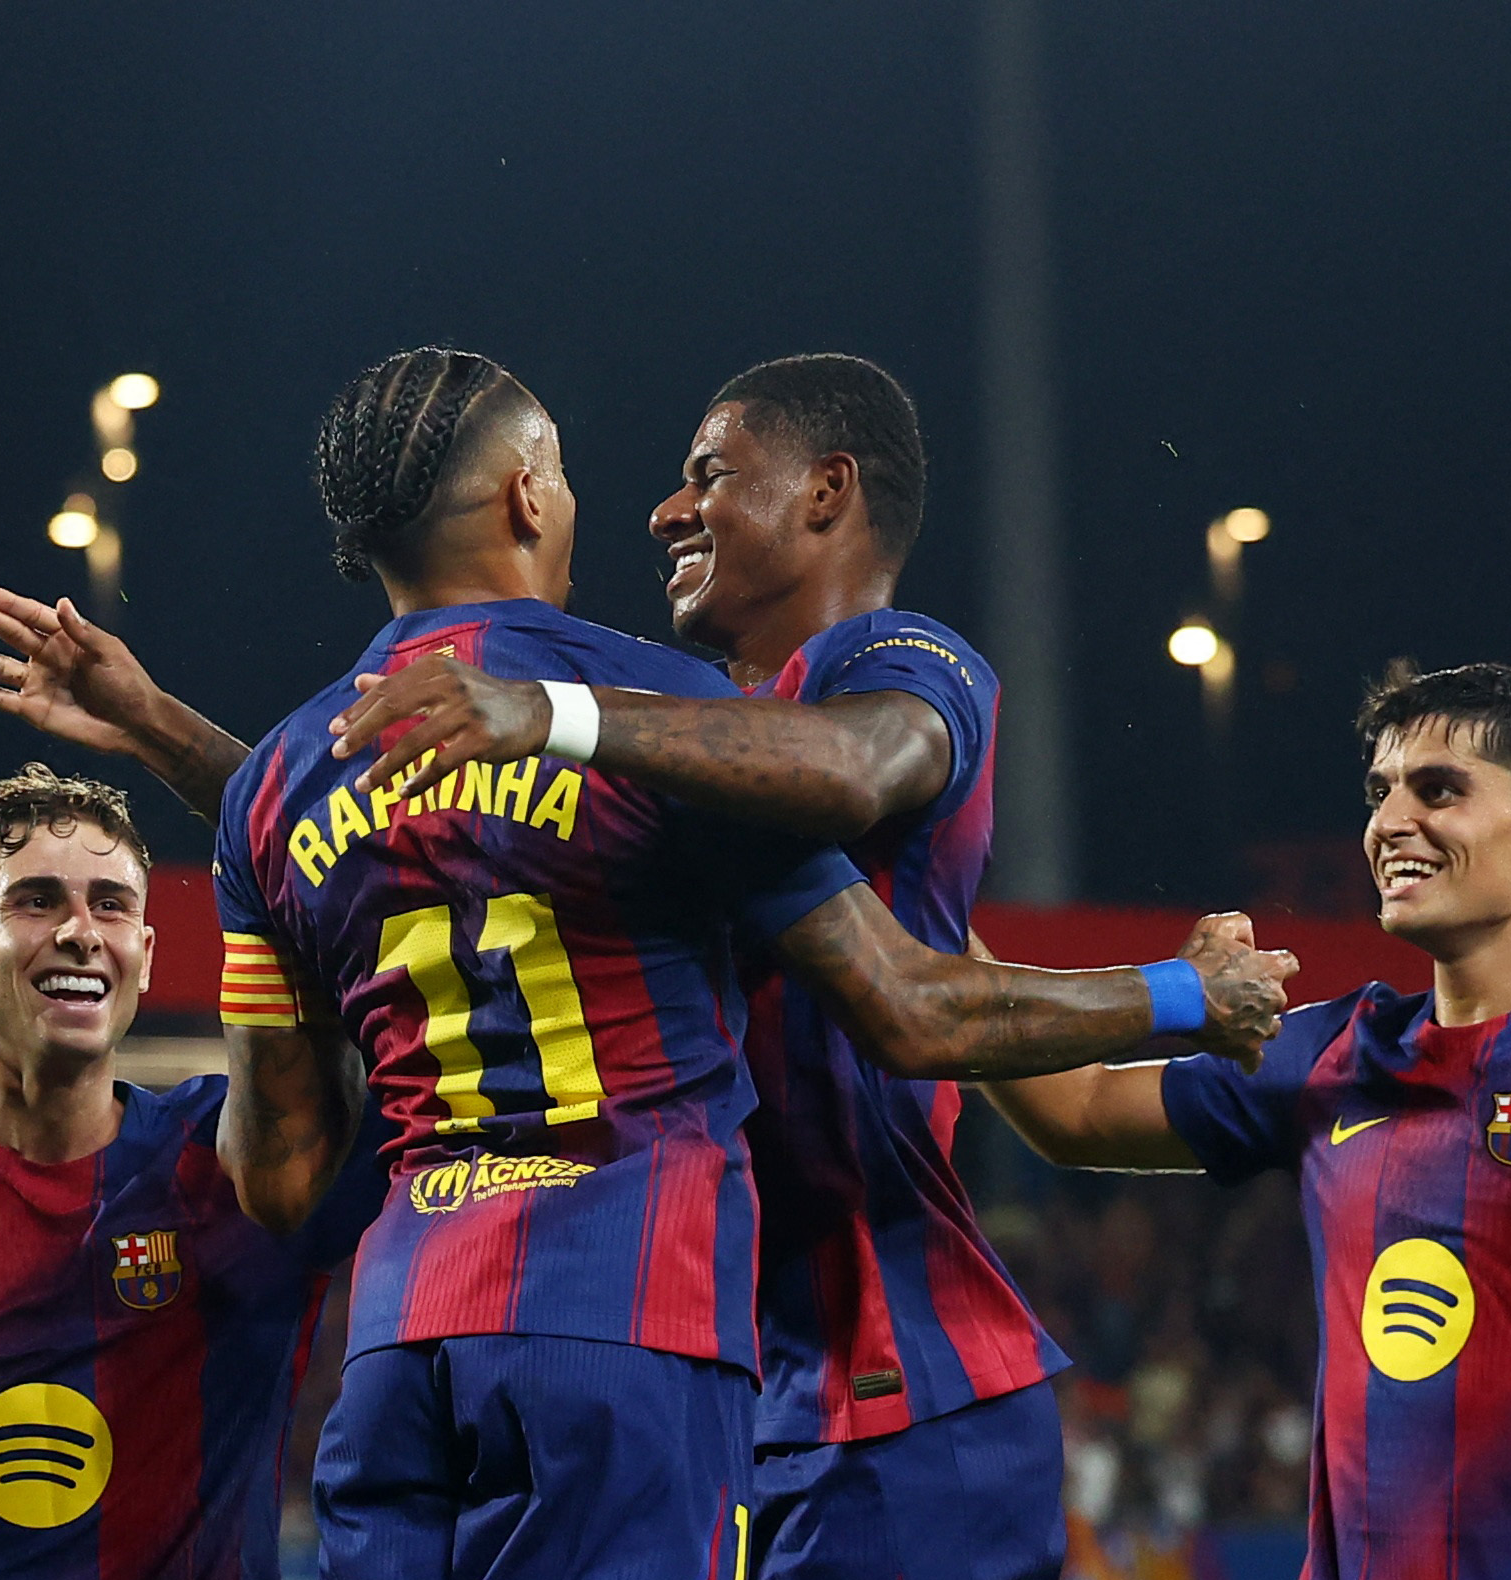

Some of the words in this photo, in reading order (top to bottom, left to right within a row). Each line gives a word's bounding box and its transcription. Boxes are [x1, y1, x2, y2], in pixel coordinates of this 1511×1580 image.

[375, 892, 605, 1135] 11
[472, 1191, 487, 1203] The
[487, 1186, 500, 1198] UN
[500, 1180, 538, 1193] Refugee
[538, 1178, 577, 1188] Agency
